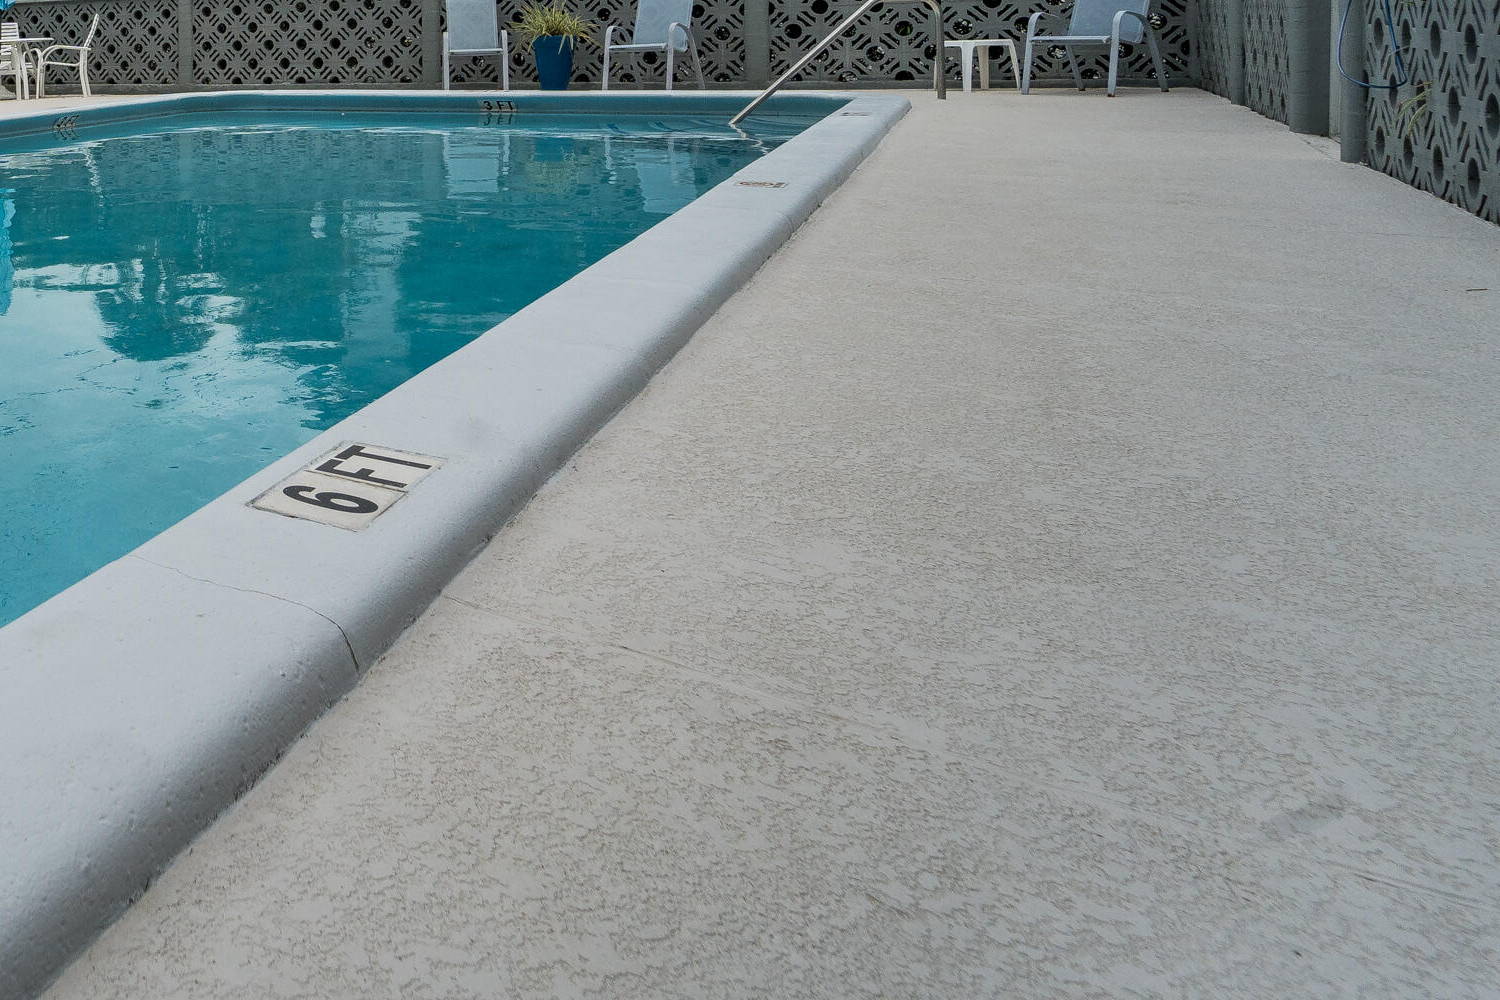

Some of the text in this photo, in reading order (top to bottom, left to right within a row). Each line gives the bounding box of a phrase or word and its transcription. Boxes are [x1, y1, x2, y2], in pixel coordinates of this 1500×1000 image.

[483, 101, 513, 110] 3 FT
[282, 444, 433, 514] 6 FT
